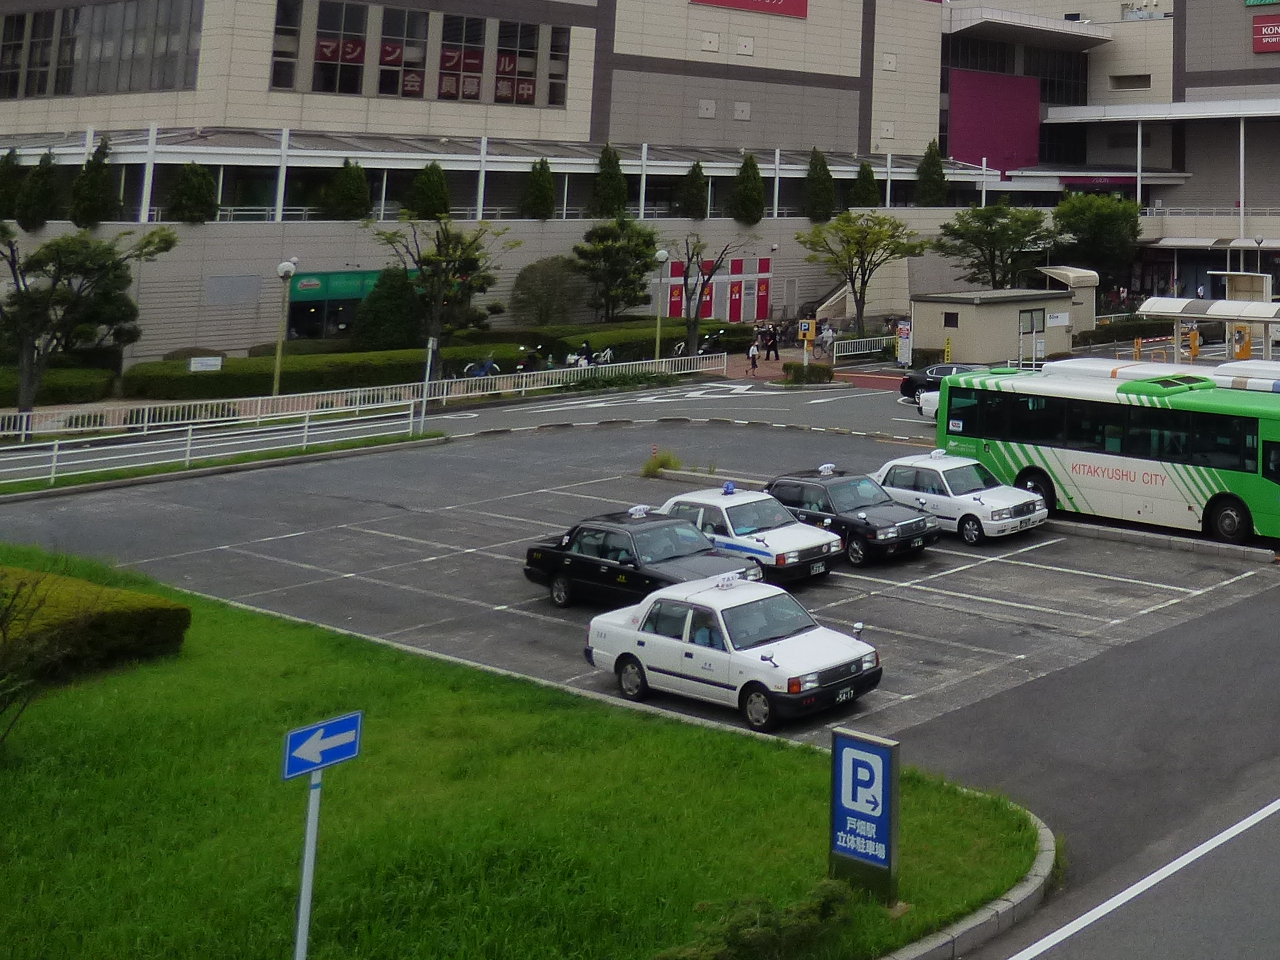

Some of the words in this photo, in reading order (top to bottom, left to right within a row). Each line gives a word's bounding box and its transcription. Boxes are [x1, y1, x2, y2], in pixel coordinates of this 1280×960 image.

[404, 73, 533, 99] 会員募集中
[1071, 463, 1137, 483] KITAKYUSHU
[1142, 472, 1167, 487] CITY
[851, 758, 876, 803] P
[846, 816, 877, 839] 戸畑駅
